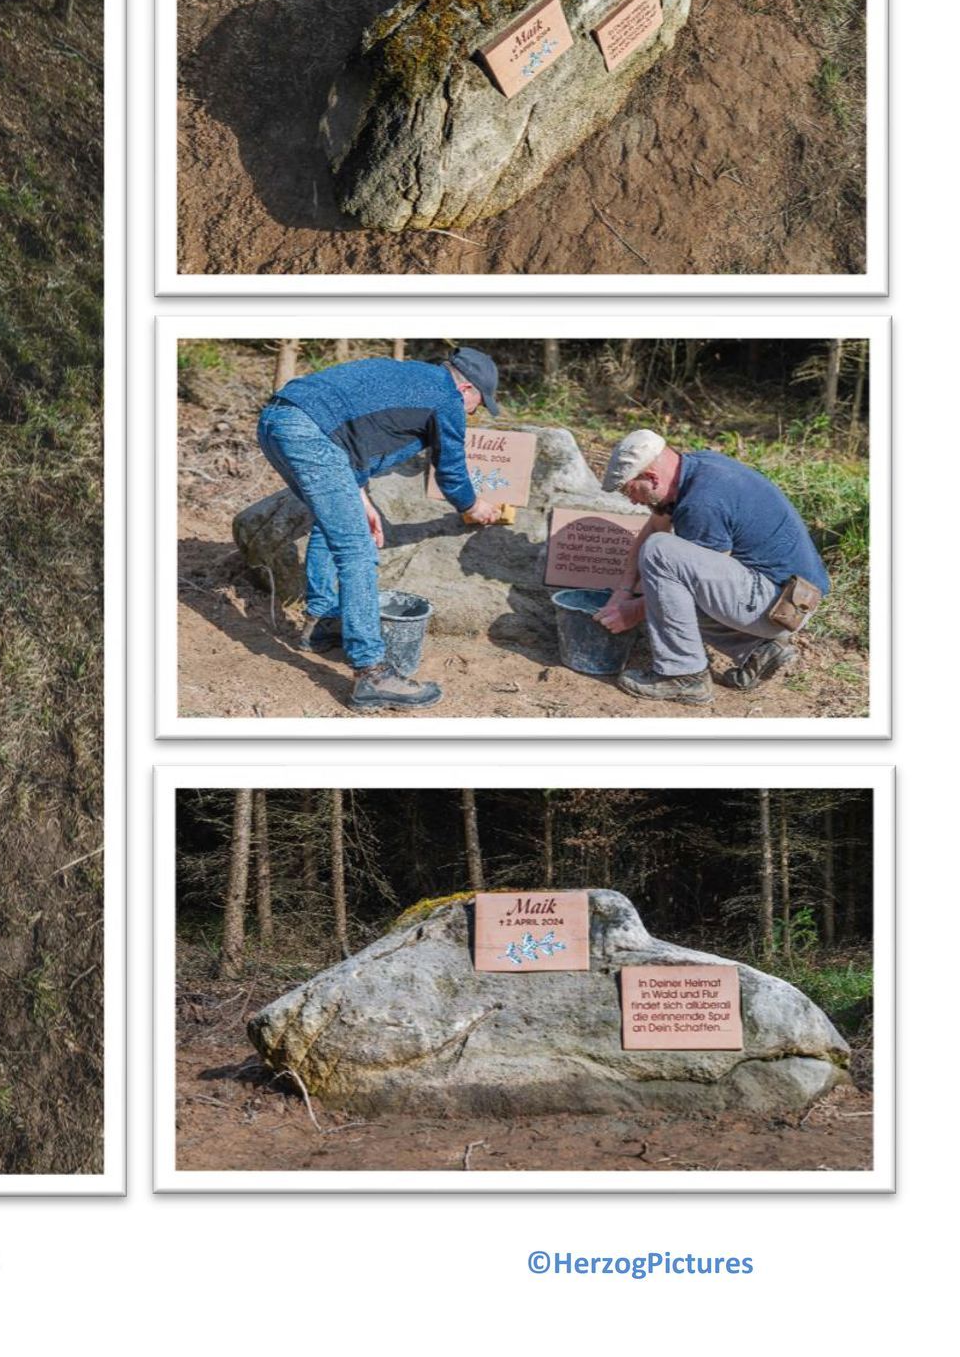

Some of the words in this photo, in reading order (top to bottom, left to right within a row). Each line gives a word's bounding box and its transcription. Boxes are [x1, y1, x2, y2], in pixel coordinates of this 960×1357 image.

[505, 897, 557, 916] Maik
[514, 918, 541, 927] APRIL
[541, 917, 564, 927] 2024
[649, 978, 682, 988] Deiner
[684, 977, 722, 988] Heimat
[651, 990, 678, 999] Wald
[680, 990, 700, 999] und
[701, 989, 720, 999] Flur
[631, 1001, 661, 1010] findet
[663, 1001, 684, 1010] sich
[632, 1012, 649, 1022] die
[708, 1011, 731, 1022] Spur
[632, 1024, 646, 1033] an
[648, 1022, 672, 1033] Dein
[528, 1250, 754, 1280] ©HerzogPictures
